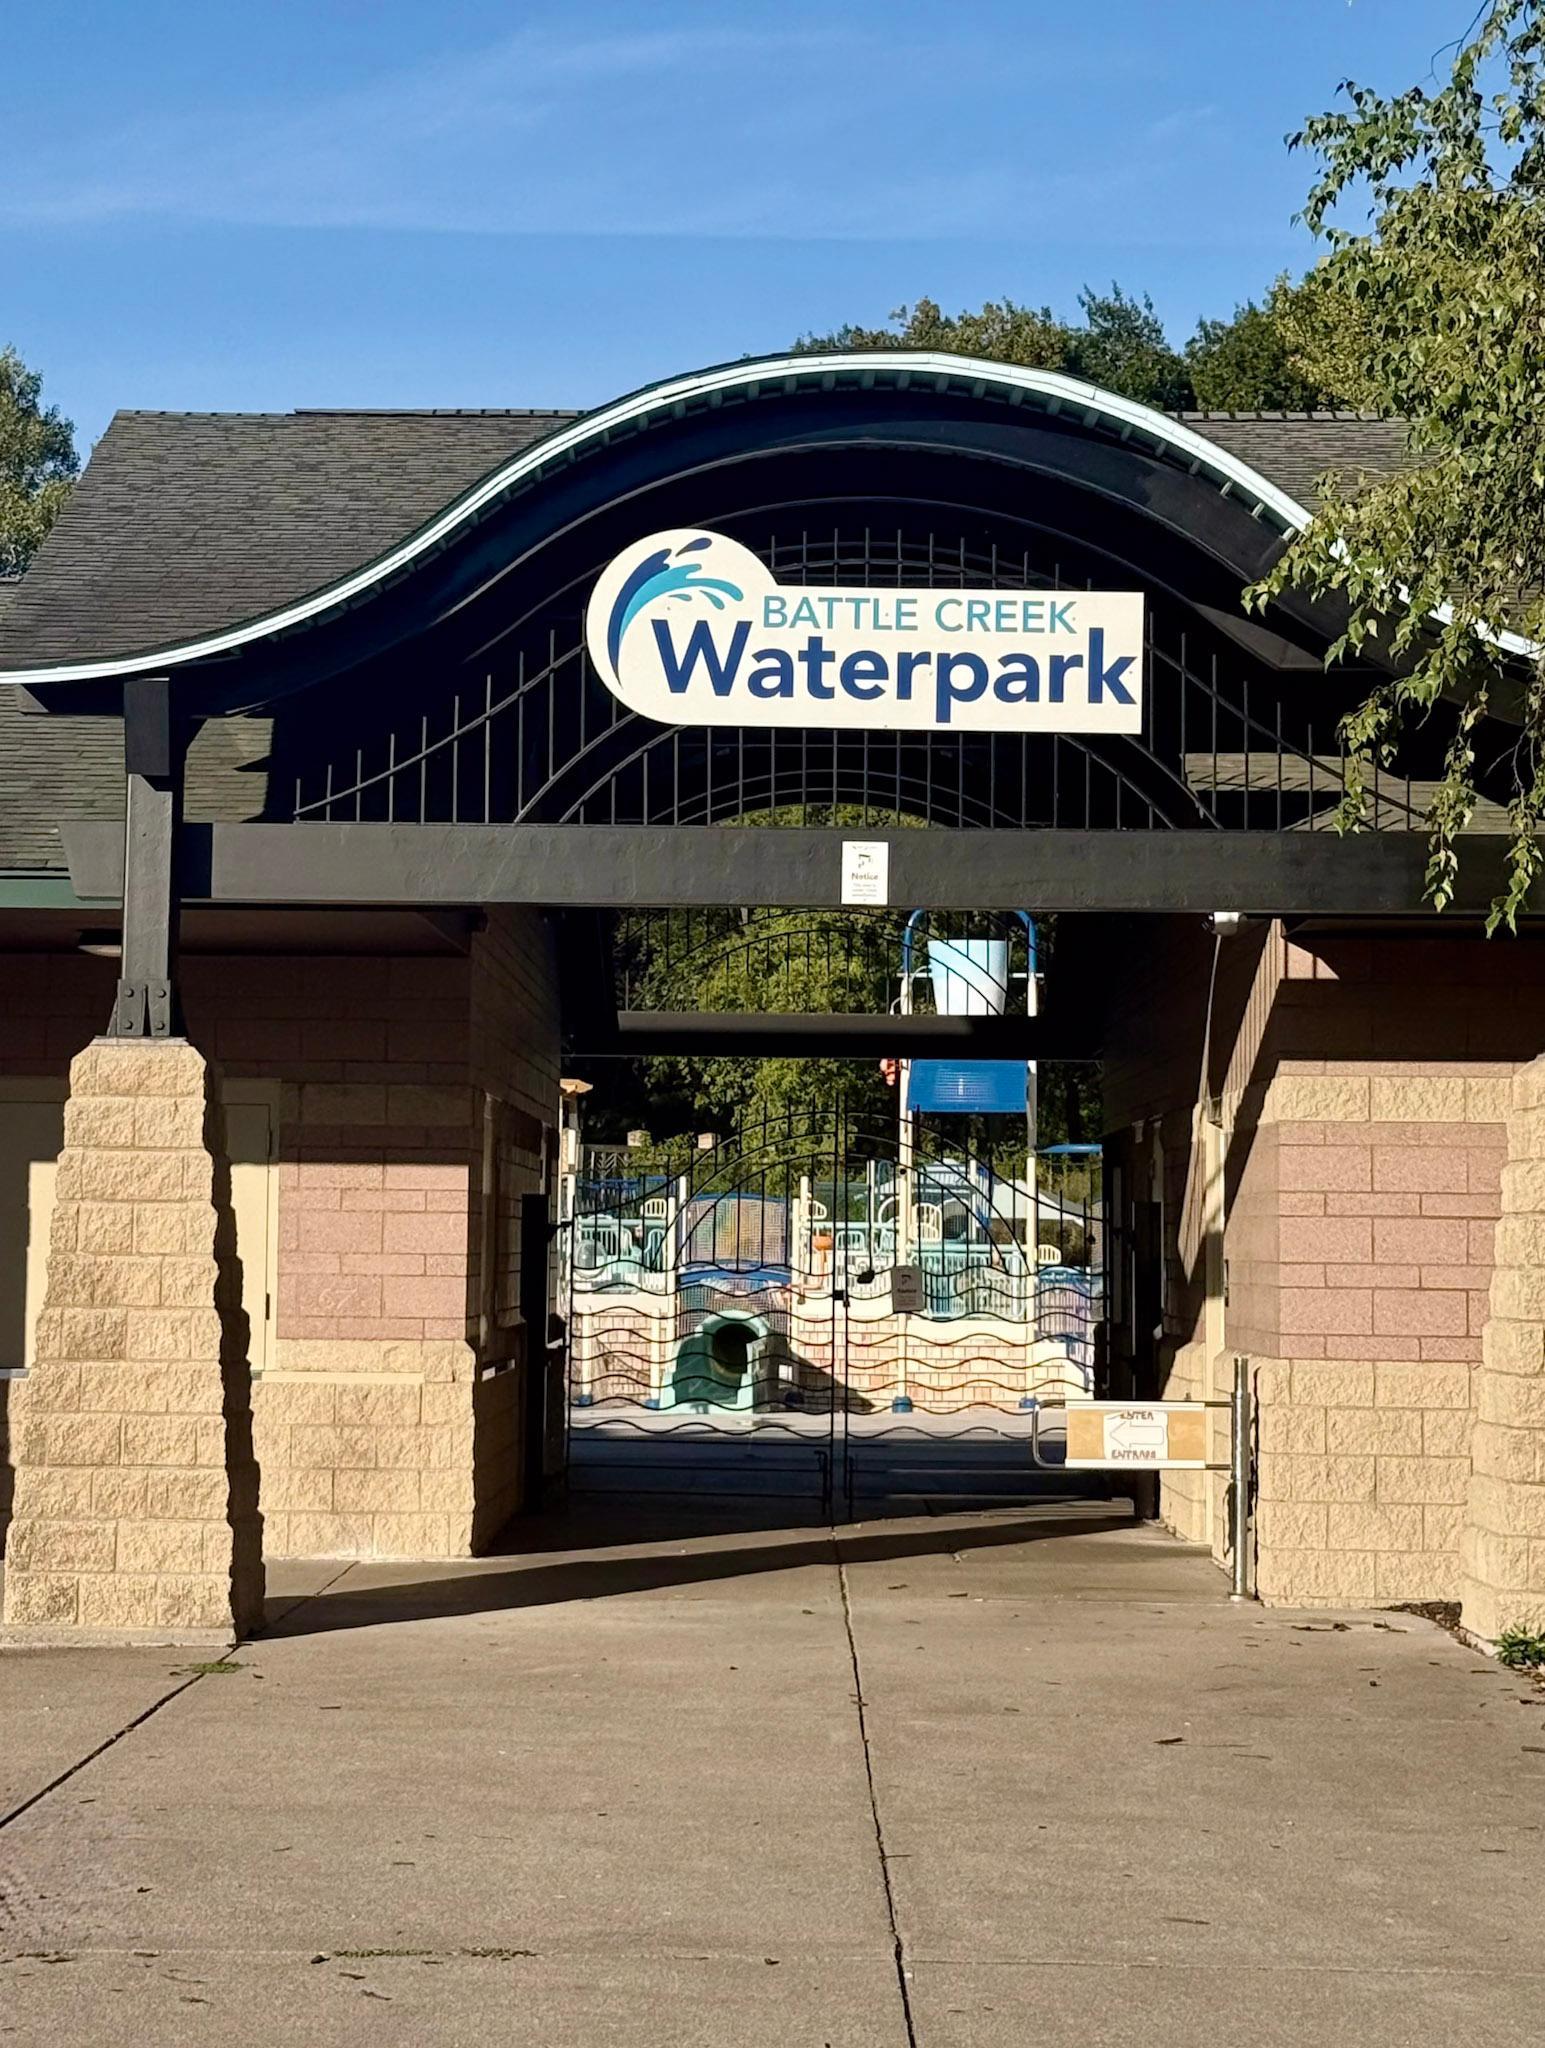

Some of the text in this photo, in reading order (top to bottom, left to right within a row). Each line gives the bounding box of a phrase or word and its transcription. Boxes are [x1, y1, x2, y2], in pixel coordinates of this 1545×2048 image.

[762, 595, 1077, 635] BATTLE CREEK
[650, 618, 1138, 723] Waterpark
[851, 871, 879, 881] Notice
[1119, 1410, 1154, 1421] ENTER
